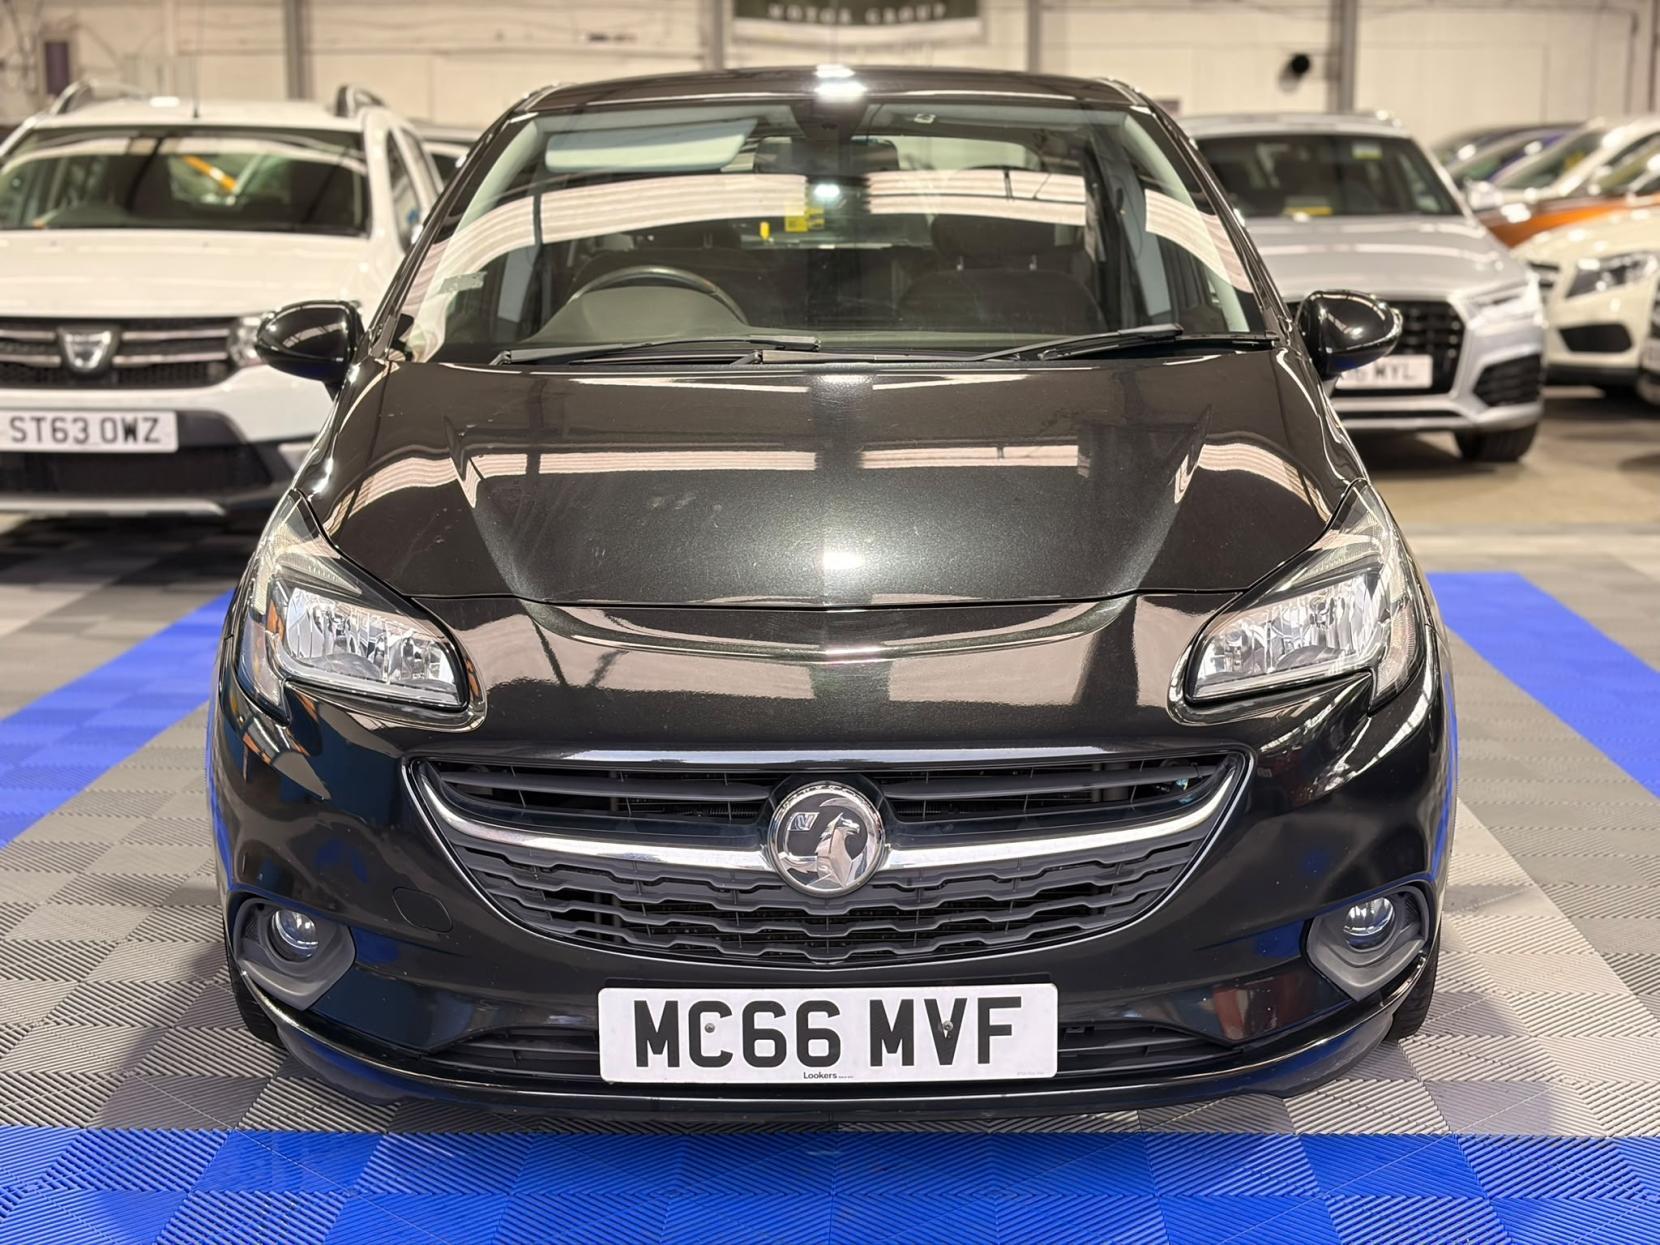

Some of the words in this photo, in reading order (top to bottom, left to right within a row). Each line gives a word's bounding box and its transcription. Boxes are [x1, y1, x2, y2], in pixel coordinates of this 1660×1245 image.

[9, 416, 90, 444] ST63
[100, 416, 161, 444] OWZ
[633, 1000, 842, 1068] MC66
[868, 996, 1022, 1067] MVF
[803, 1072, 838, 1080] Lookers
